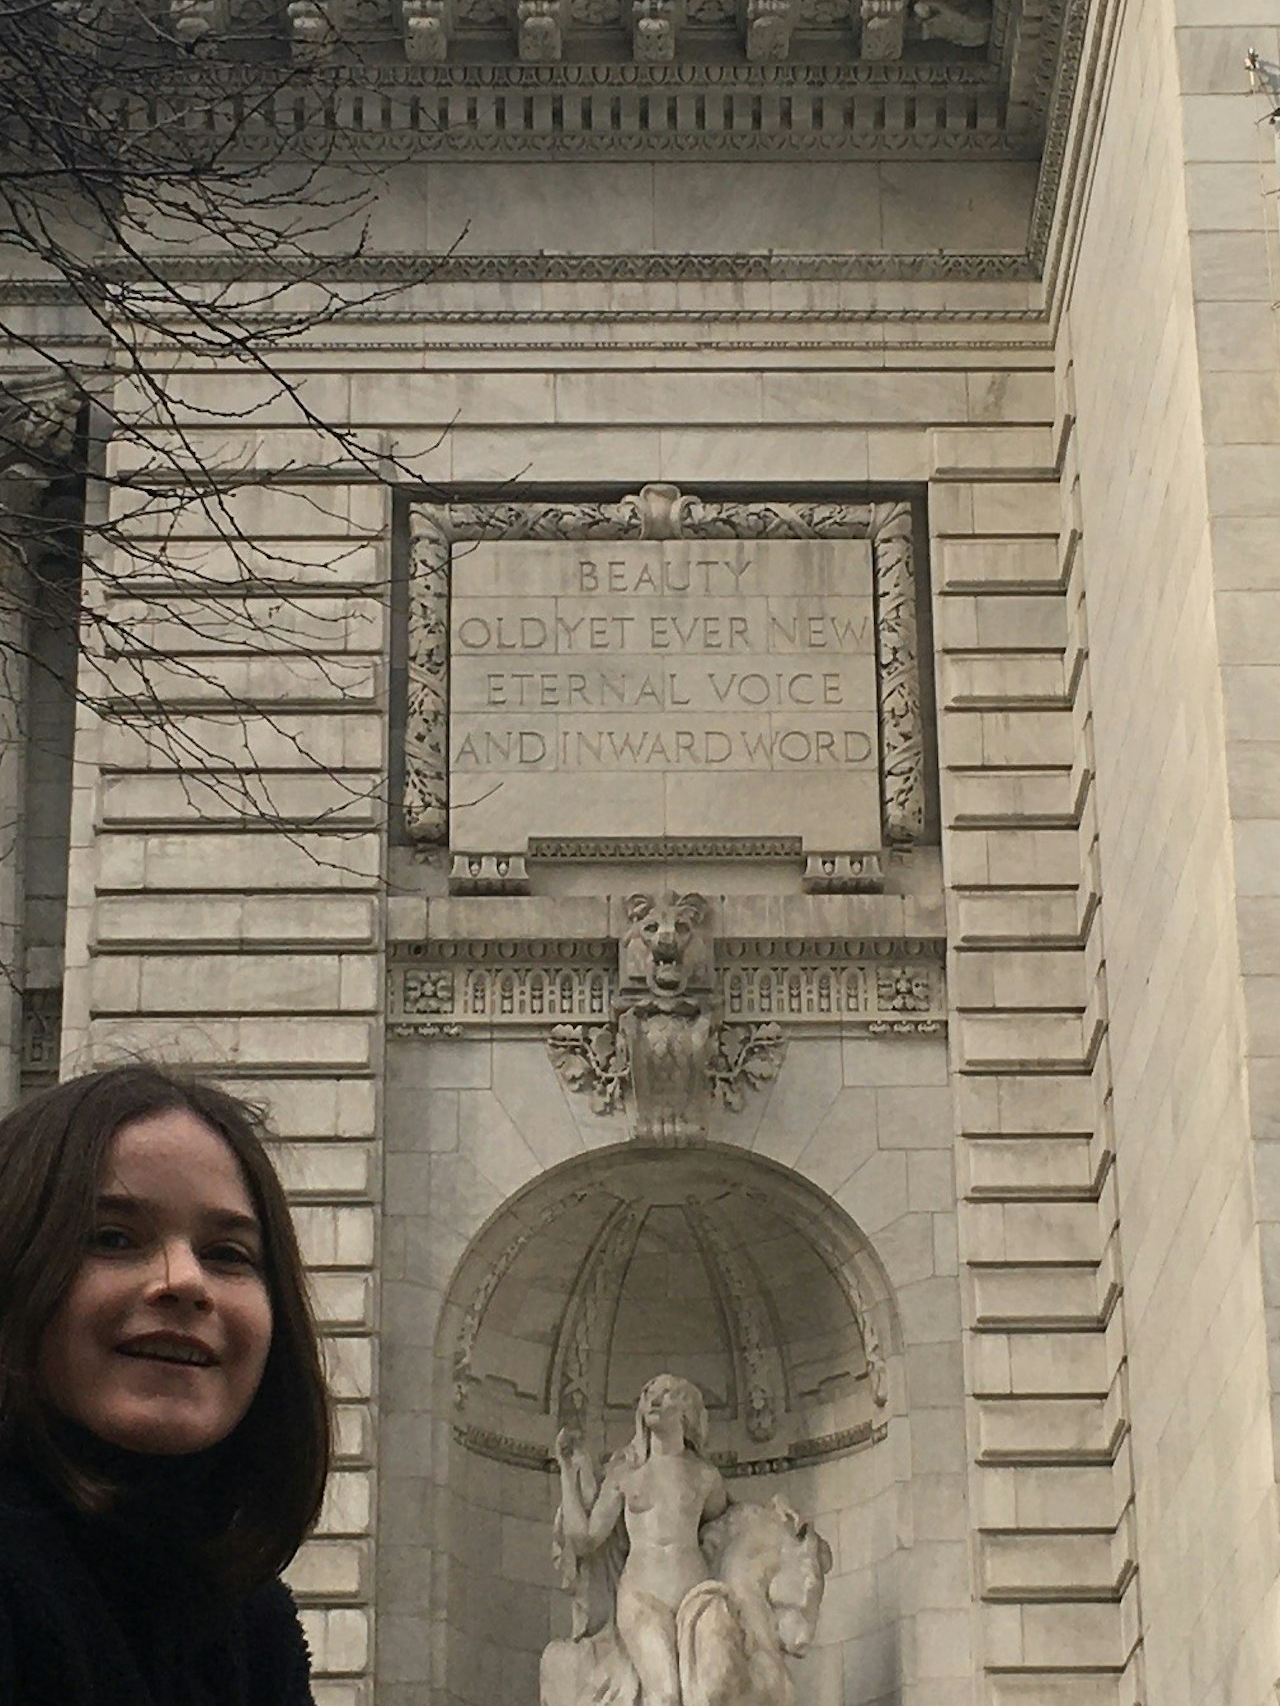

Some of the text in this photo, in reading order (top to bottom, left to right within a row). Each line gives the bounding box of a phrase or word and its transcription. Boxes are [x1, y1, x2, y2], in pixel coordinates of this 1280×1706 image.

[579, 560, 753, 594] BEAUTY
[457, 615, 869, 650] OLD YET EVER NEW
[486, 672, 844, 706] ETERNAL VOICE
[453, 730, 873, 765] AND INWARD WORD
